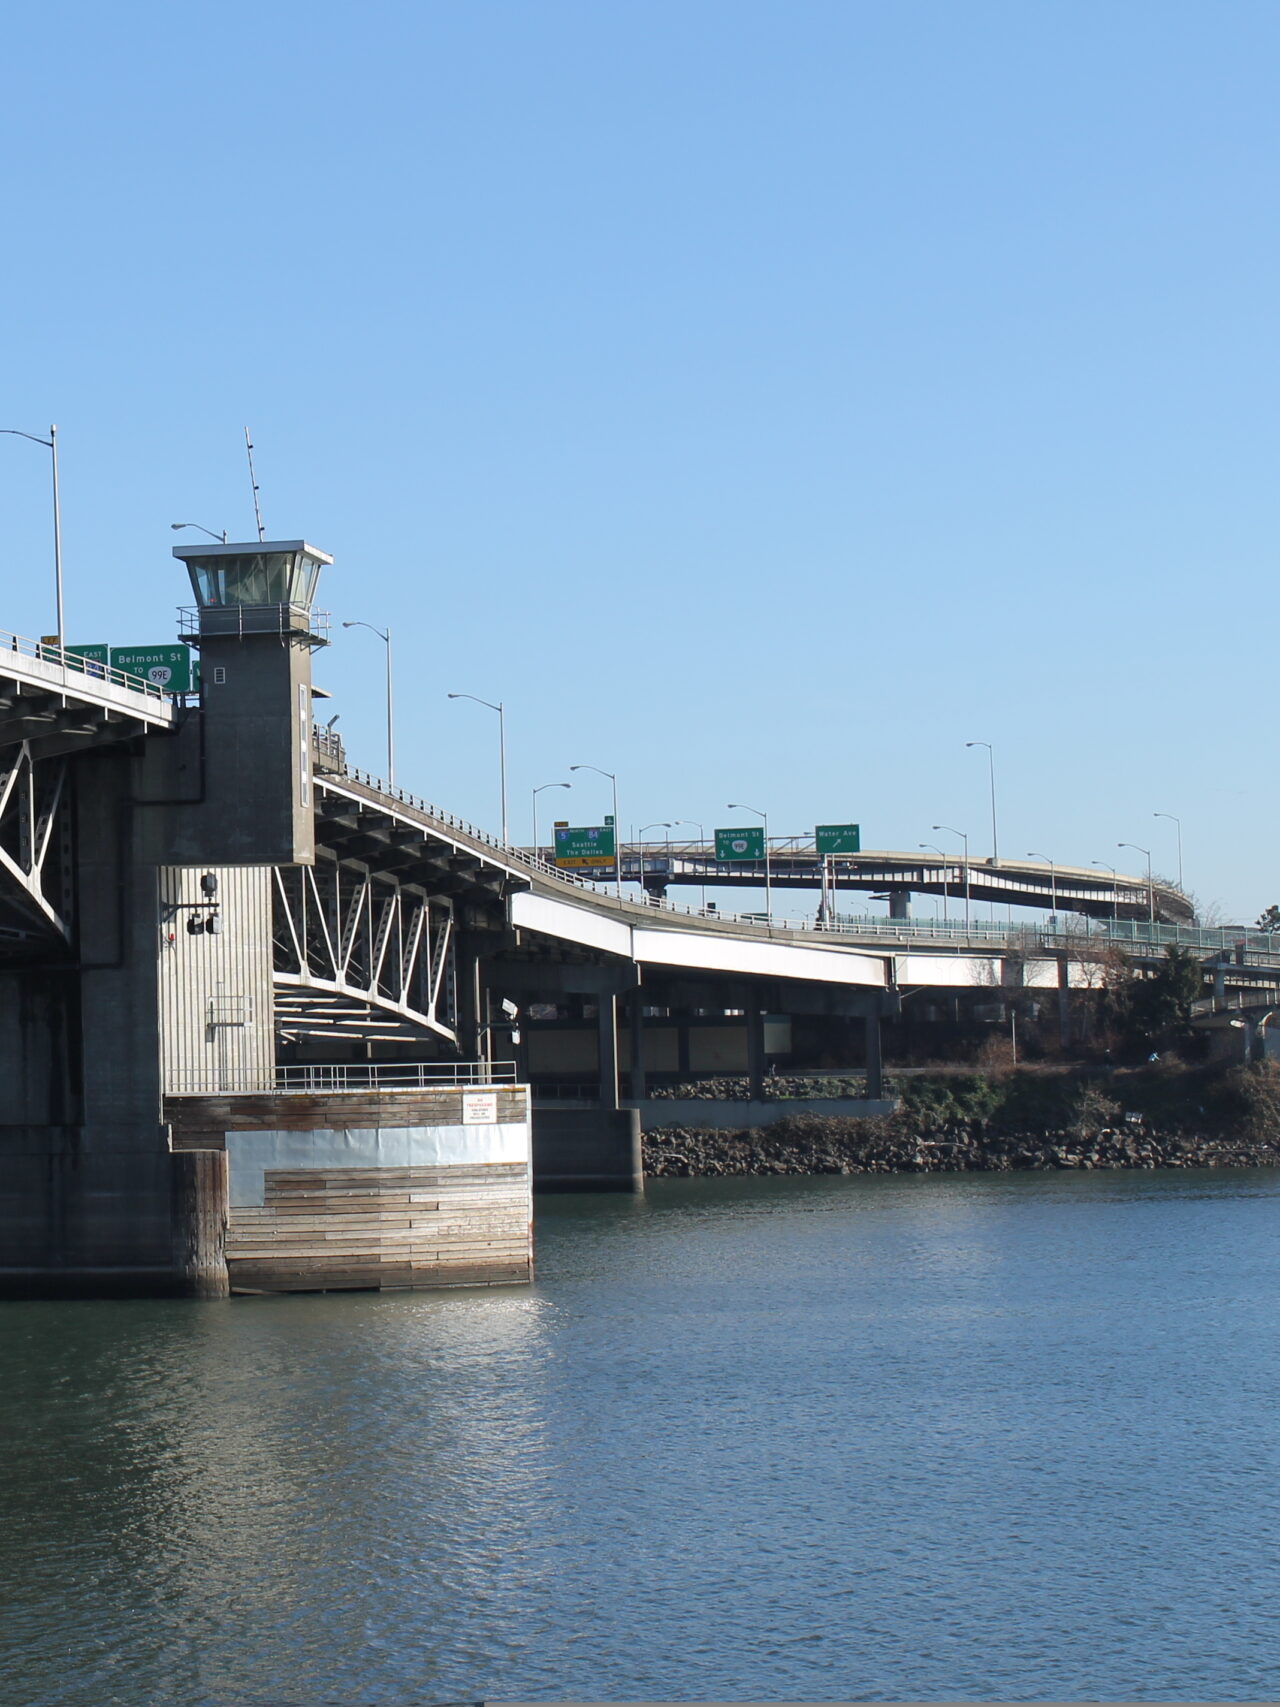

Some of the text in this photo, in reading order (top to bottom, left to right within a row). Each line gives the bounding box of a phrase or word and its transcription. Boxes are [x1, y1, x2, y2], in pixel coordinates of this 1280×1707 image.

[119, 652, 181, 664] Belmont St
[151, 670, 168, 680] 99E
[588, 831, 598, 839] 84
